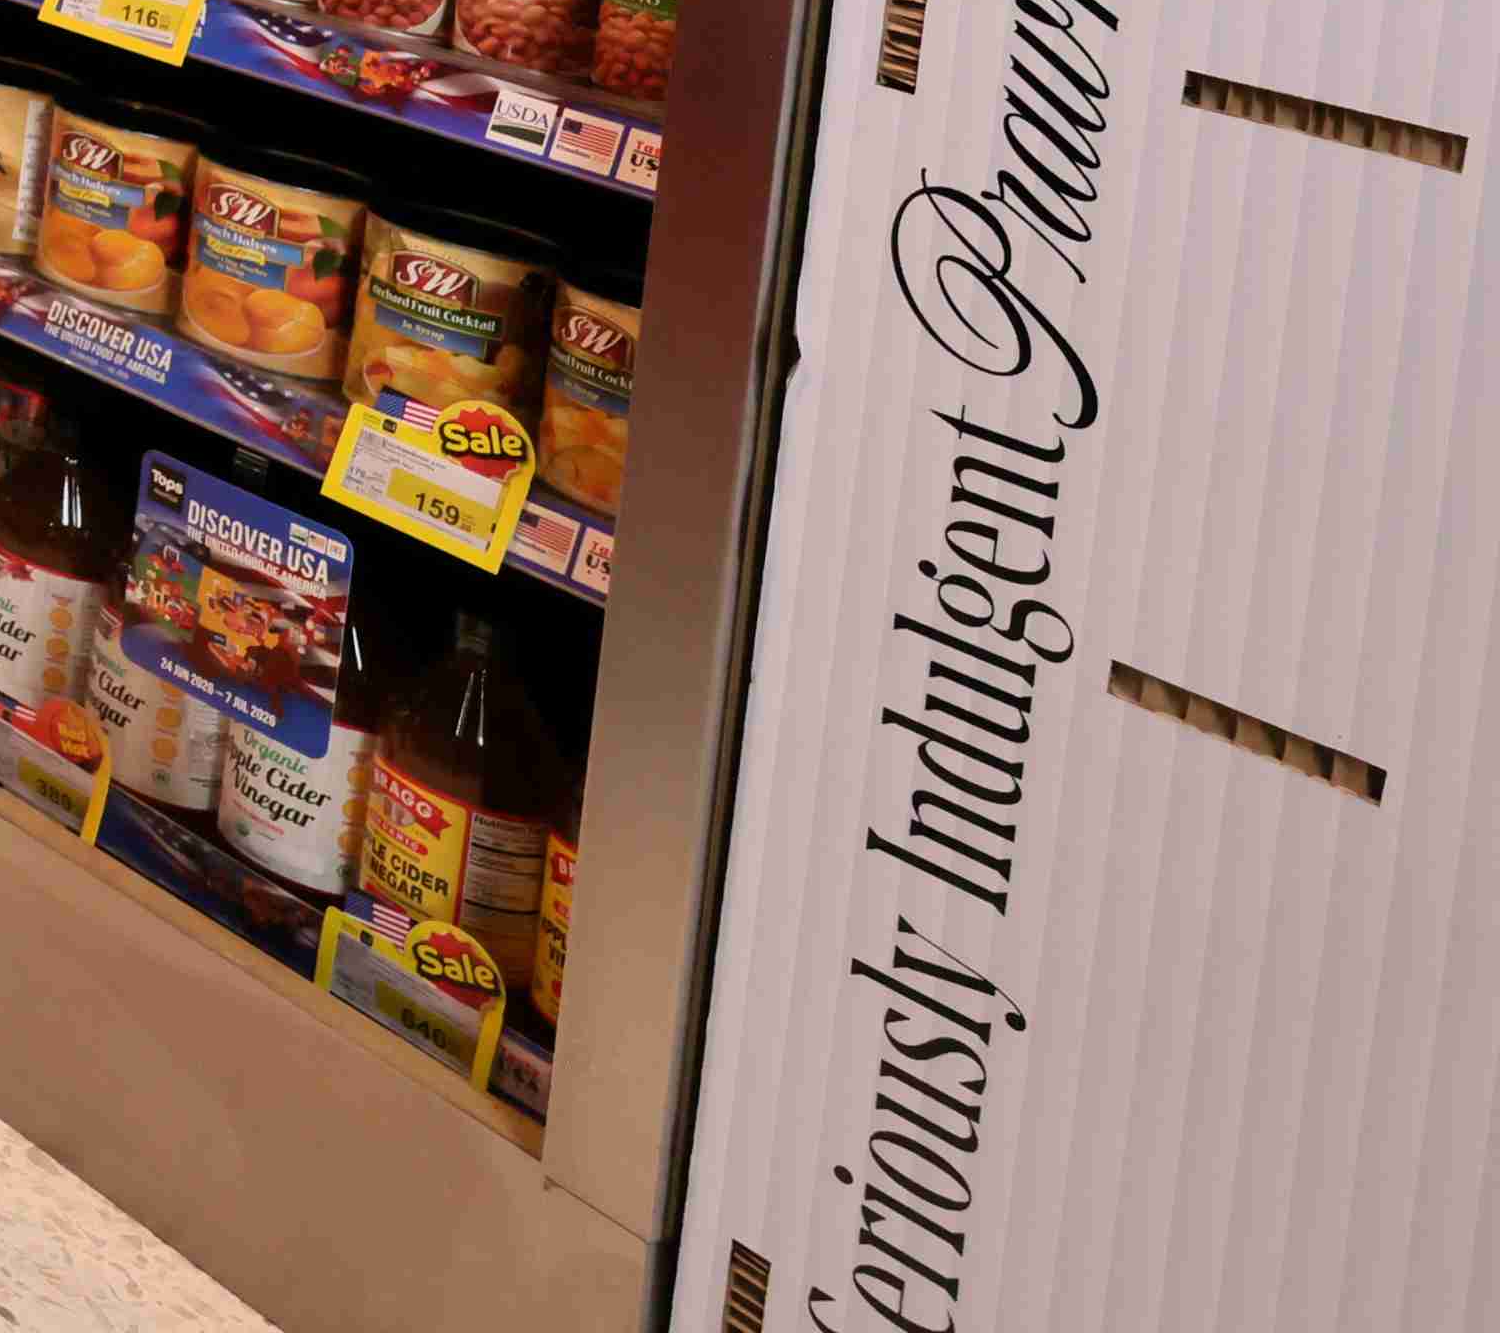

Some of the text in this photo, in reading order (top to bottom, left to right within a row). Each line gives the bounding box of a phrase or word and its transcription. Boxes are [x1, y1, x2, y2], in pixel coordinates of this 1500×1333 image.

[122, 4, 159, 28] 116
[497, 99, 549, 129] USDA
[46, 299, 173, 372] DISCOVER USA
[409, 298, 497, 332] Fruit Cocktail
[414, 492, 460, 524] 159
[187, 497, 331, 585] DISCOVER USA
[866, 404, 1074, 916] Indulgent
[233, 771, 316, 830] Vinegar
[266, 767, 331, 810] Cider
[390, 852, 449, 897] CIDER
[806, 915, 1028, 1333] eriously
